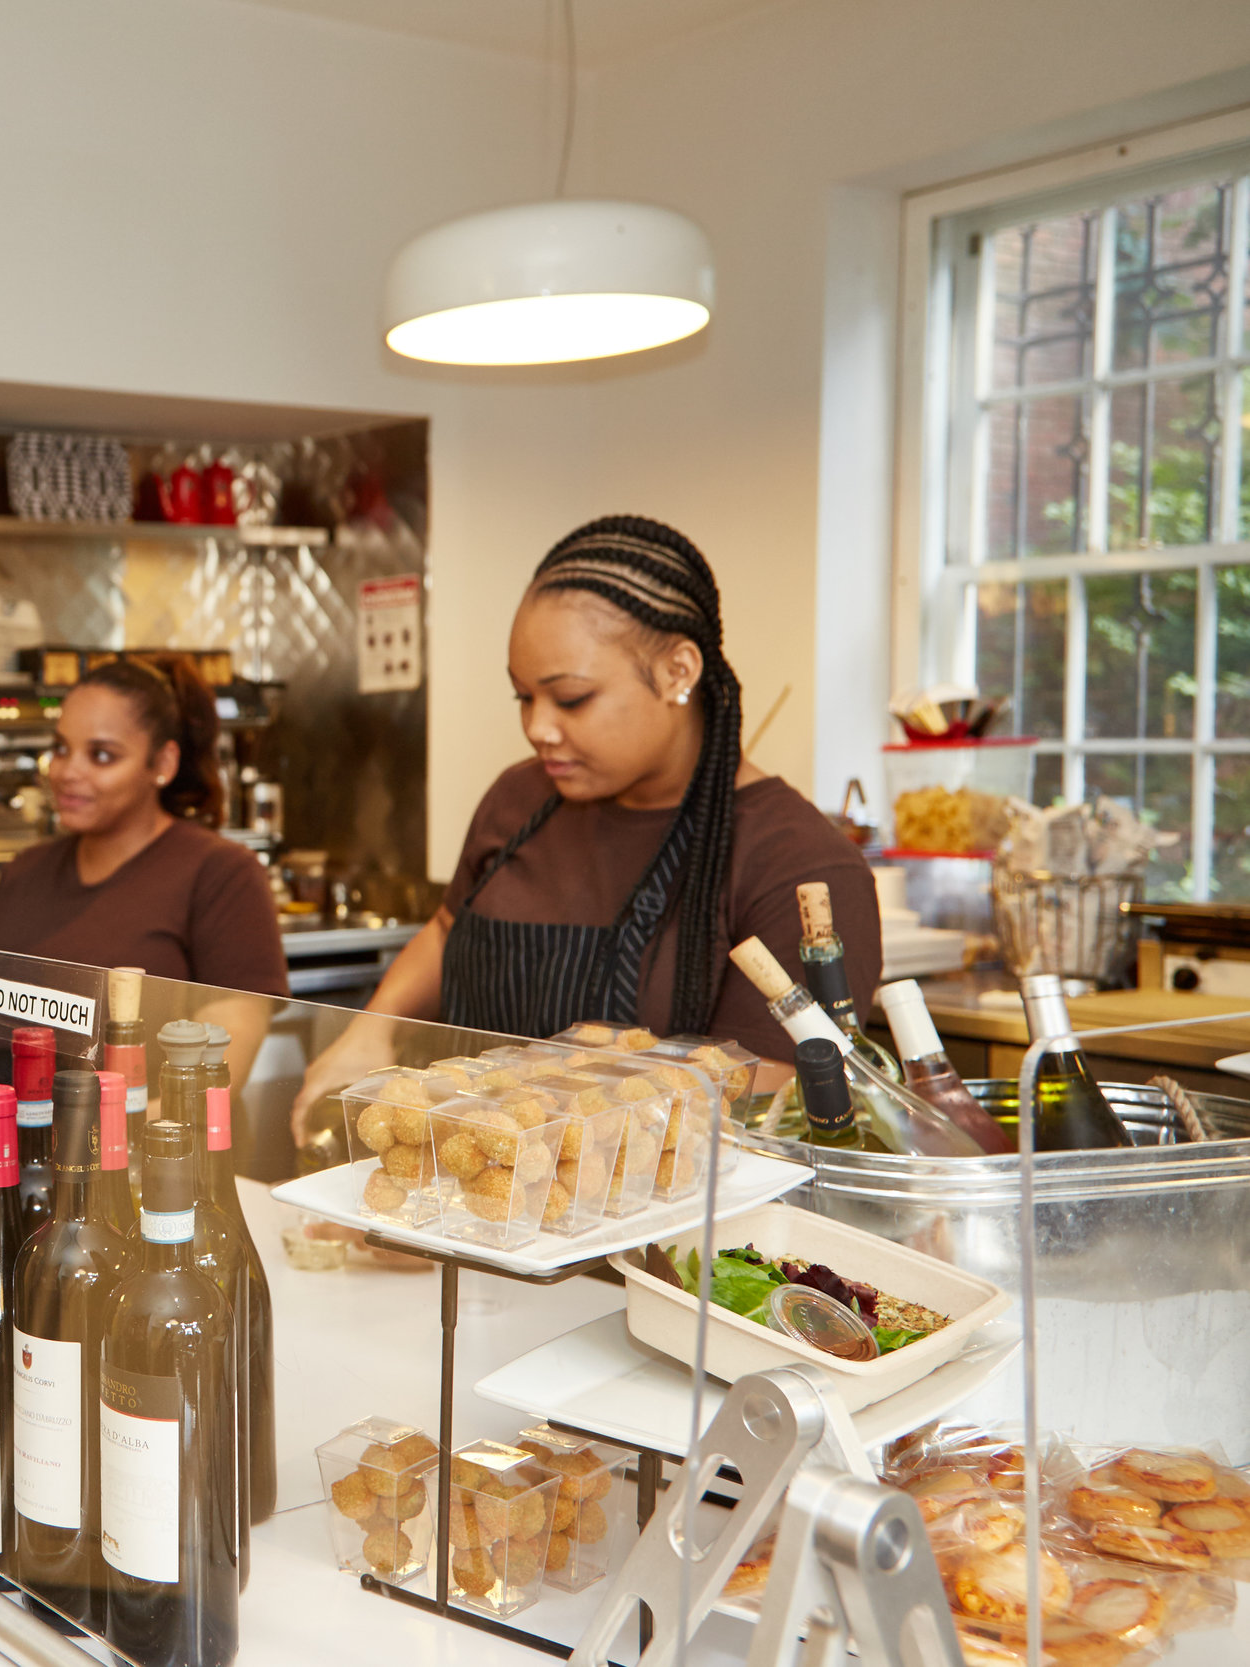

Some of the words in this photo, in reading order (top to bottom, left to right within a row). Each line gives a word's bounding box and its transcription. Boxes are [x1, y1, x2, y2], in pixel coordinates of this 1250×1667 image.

[8, 991, 37, 1015] NOT
[41, 998, 89, 1026] TOUCH
[34, 1377, 55, 1388] CORVI
[112, 1431, 150, 1450] D'ALBA
